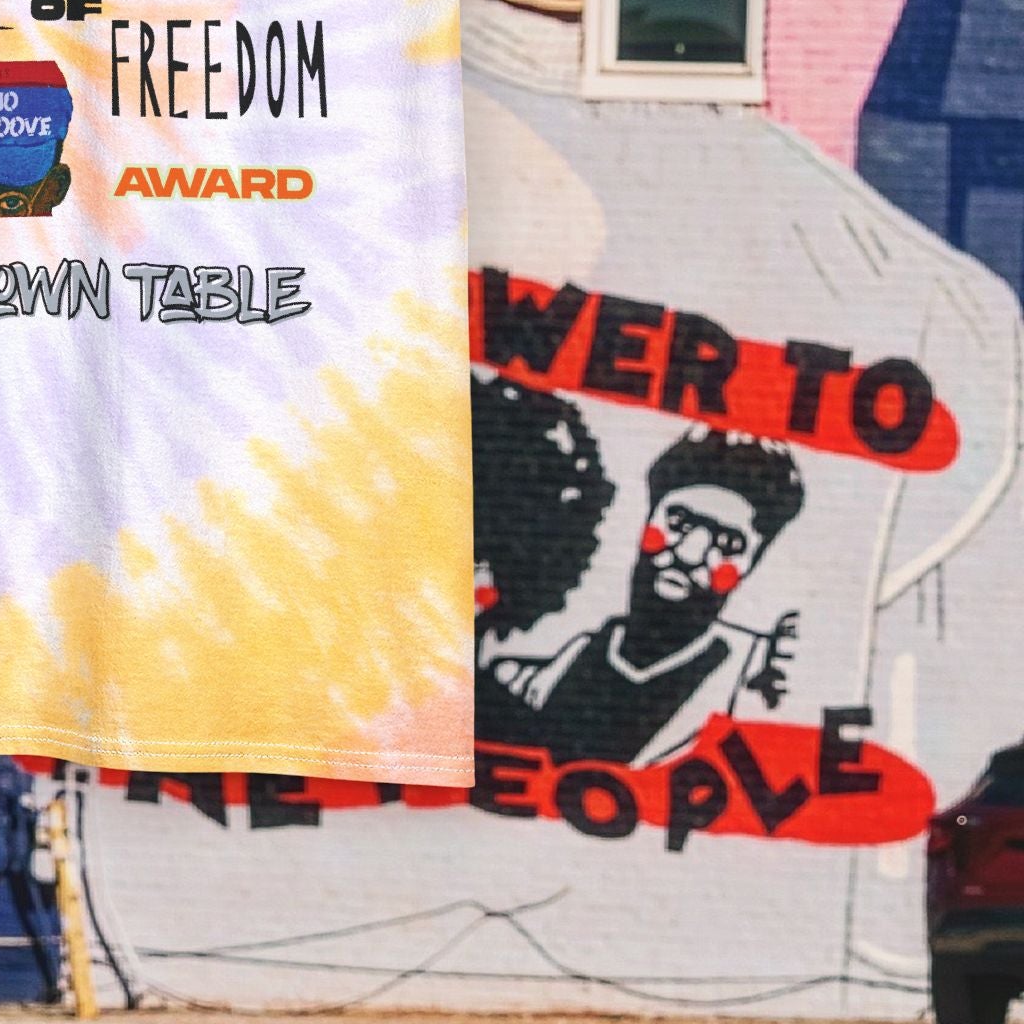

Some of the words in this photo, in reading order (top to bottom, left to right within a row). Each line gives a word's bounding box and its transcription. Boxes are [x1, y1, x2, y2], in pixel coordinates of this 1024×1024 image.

[111, 19, 328, 119] FREEDOM
[112, 165, 315, 200] AWARD
[123, 262, 313, 326] TABLE
[785, 340, 934, 455] TO
[380, 705, 882, 853] EOPLE
